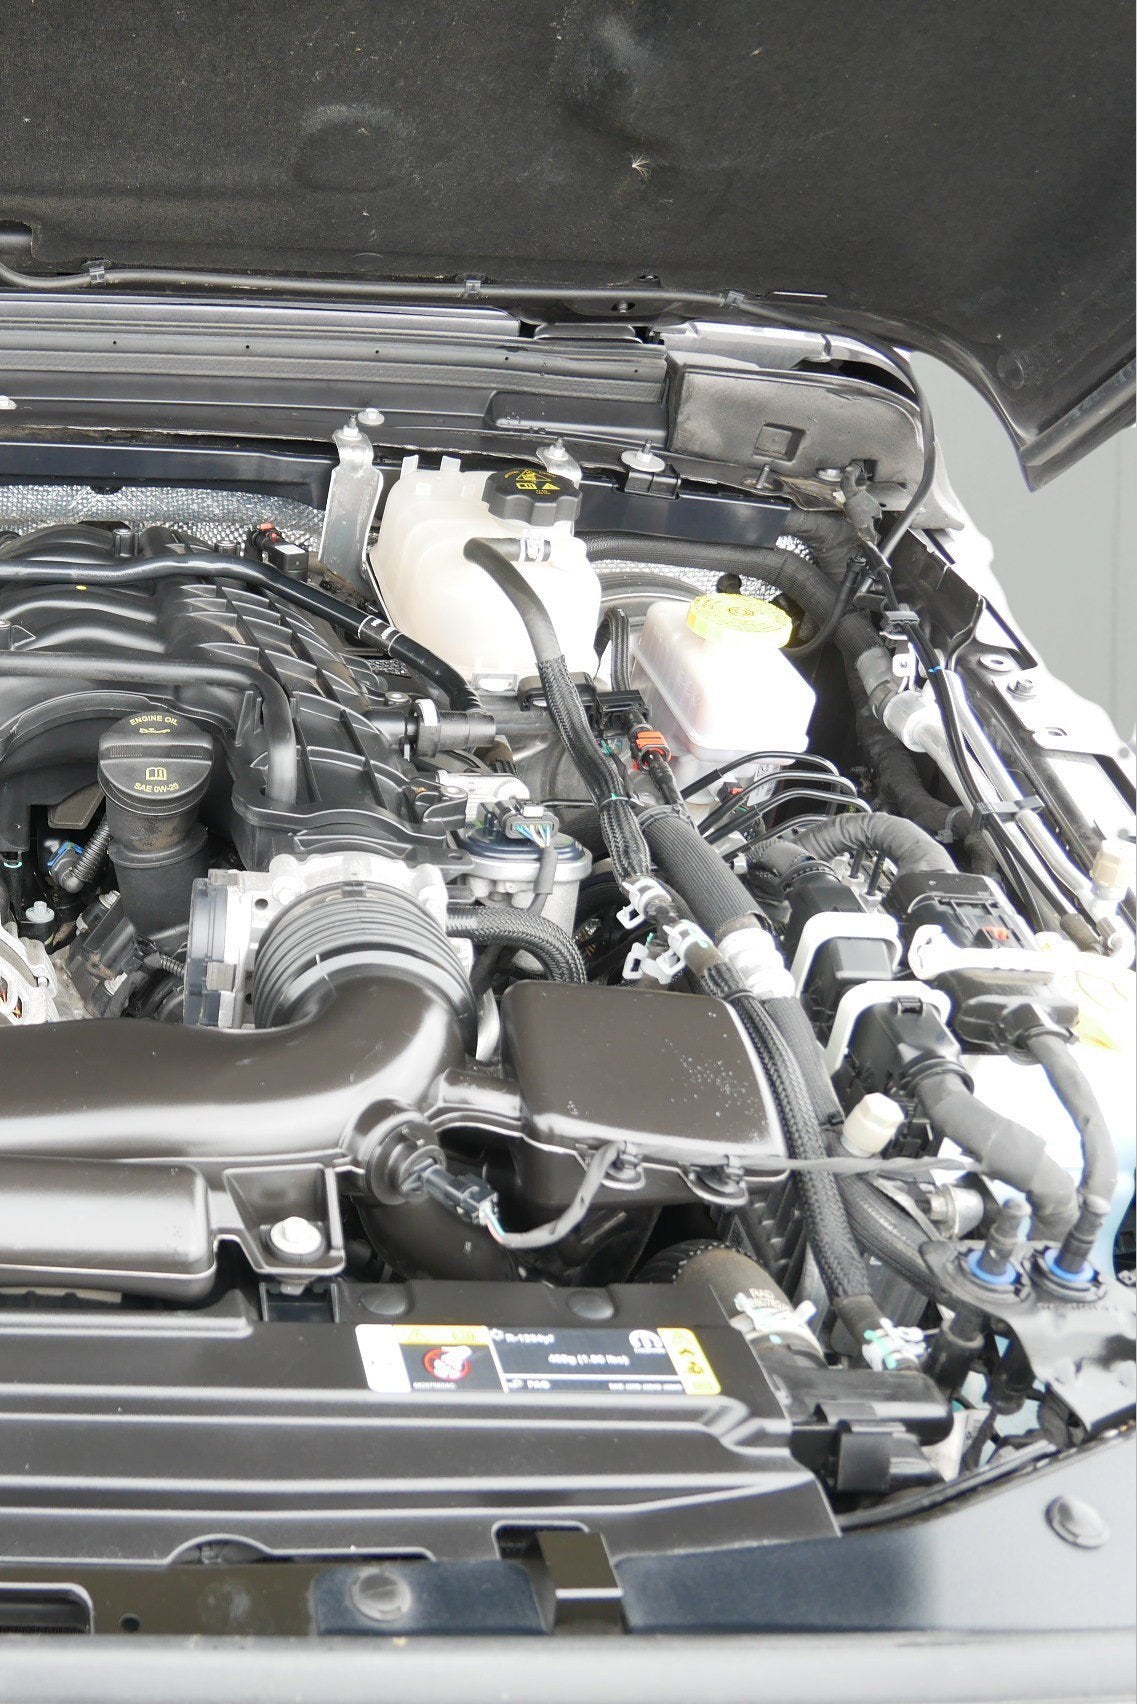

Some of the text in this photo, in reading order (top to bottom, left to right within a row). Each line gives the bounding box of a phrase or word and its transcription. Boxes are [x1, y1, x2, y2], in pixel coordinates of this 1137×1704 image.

[129, 715, 179, 726] ENGINE OIL
[133, 782, 180, 793] SAE 0W-20
